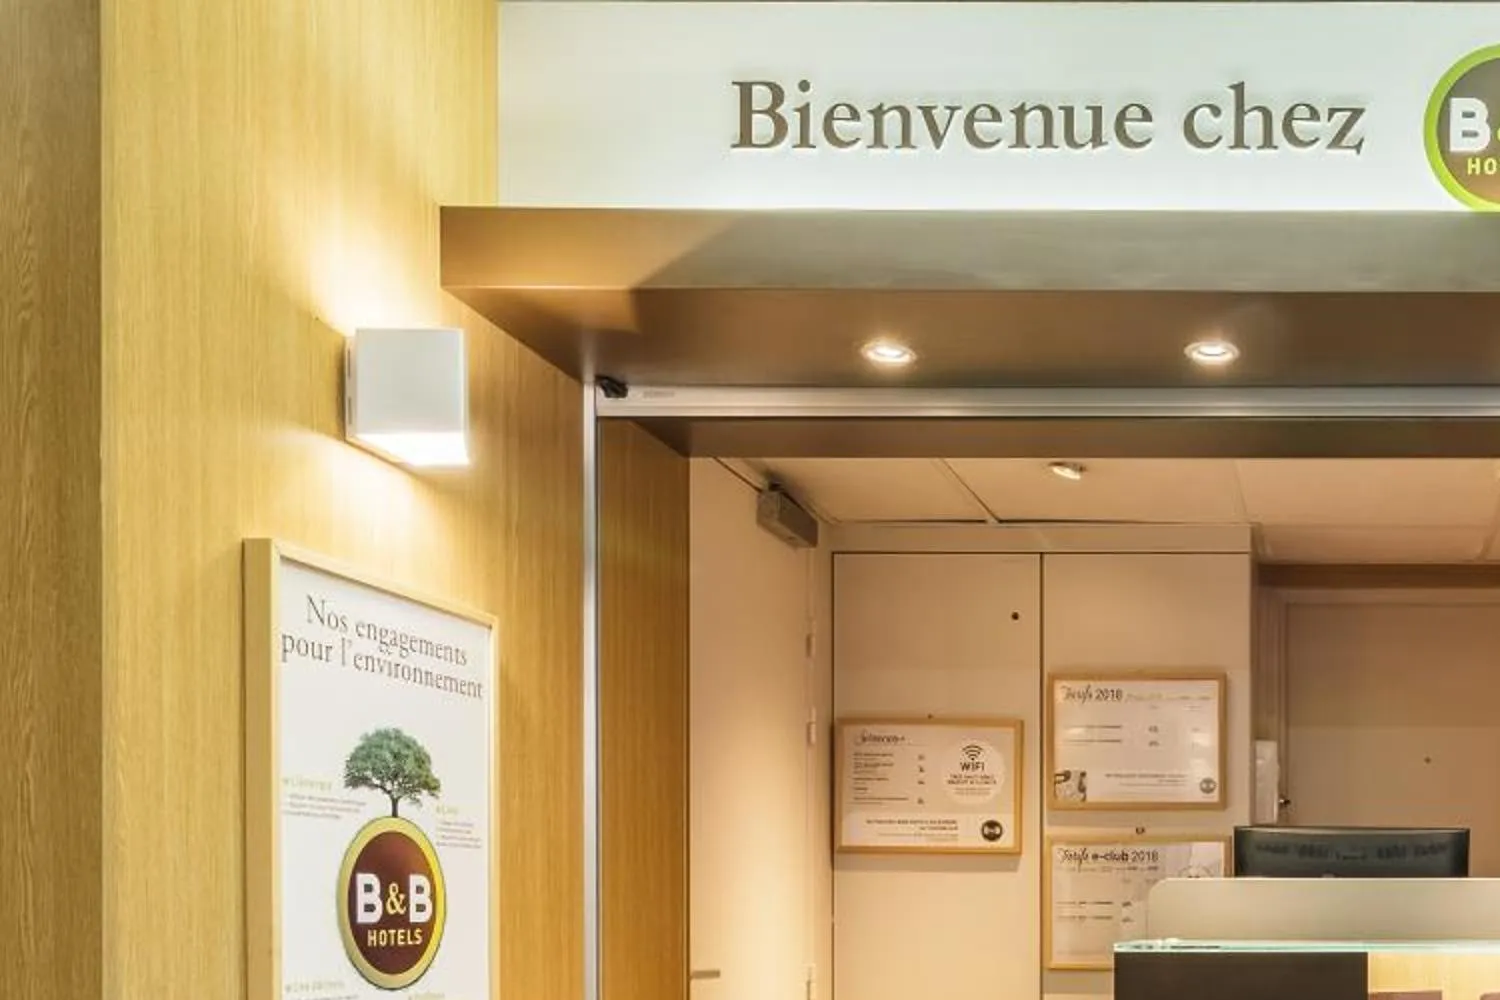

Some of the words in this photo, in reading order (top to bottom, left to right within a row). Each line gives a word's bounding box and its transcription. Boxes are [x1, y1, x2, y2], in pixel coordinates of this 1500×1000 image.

[730, 79, 1154, 150] Bienvenue
[1182, 81, 1367, 156] chez
[281, 633, 333, 664] pour
[306, 594, 349, 632] Nos
[355, 619, 467, 666] engagements
[355, 872, 434, 924] B&B
[367, 927, 423, 948] HOTELS
